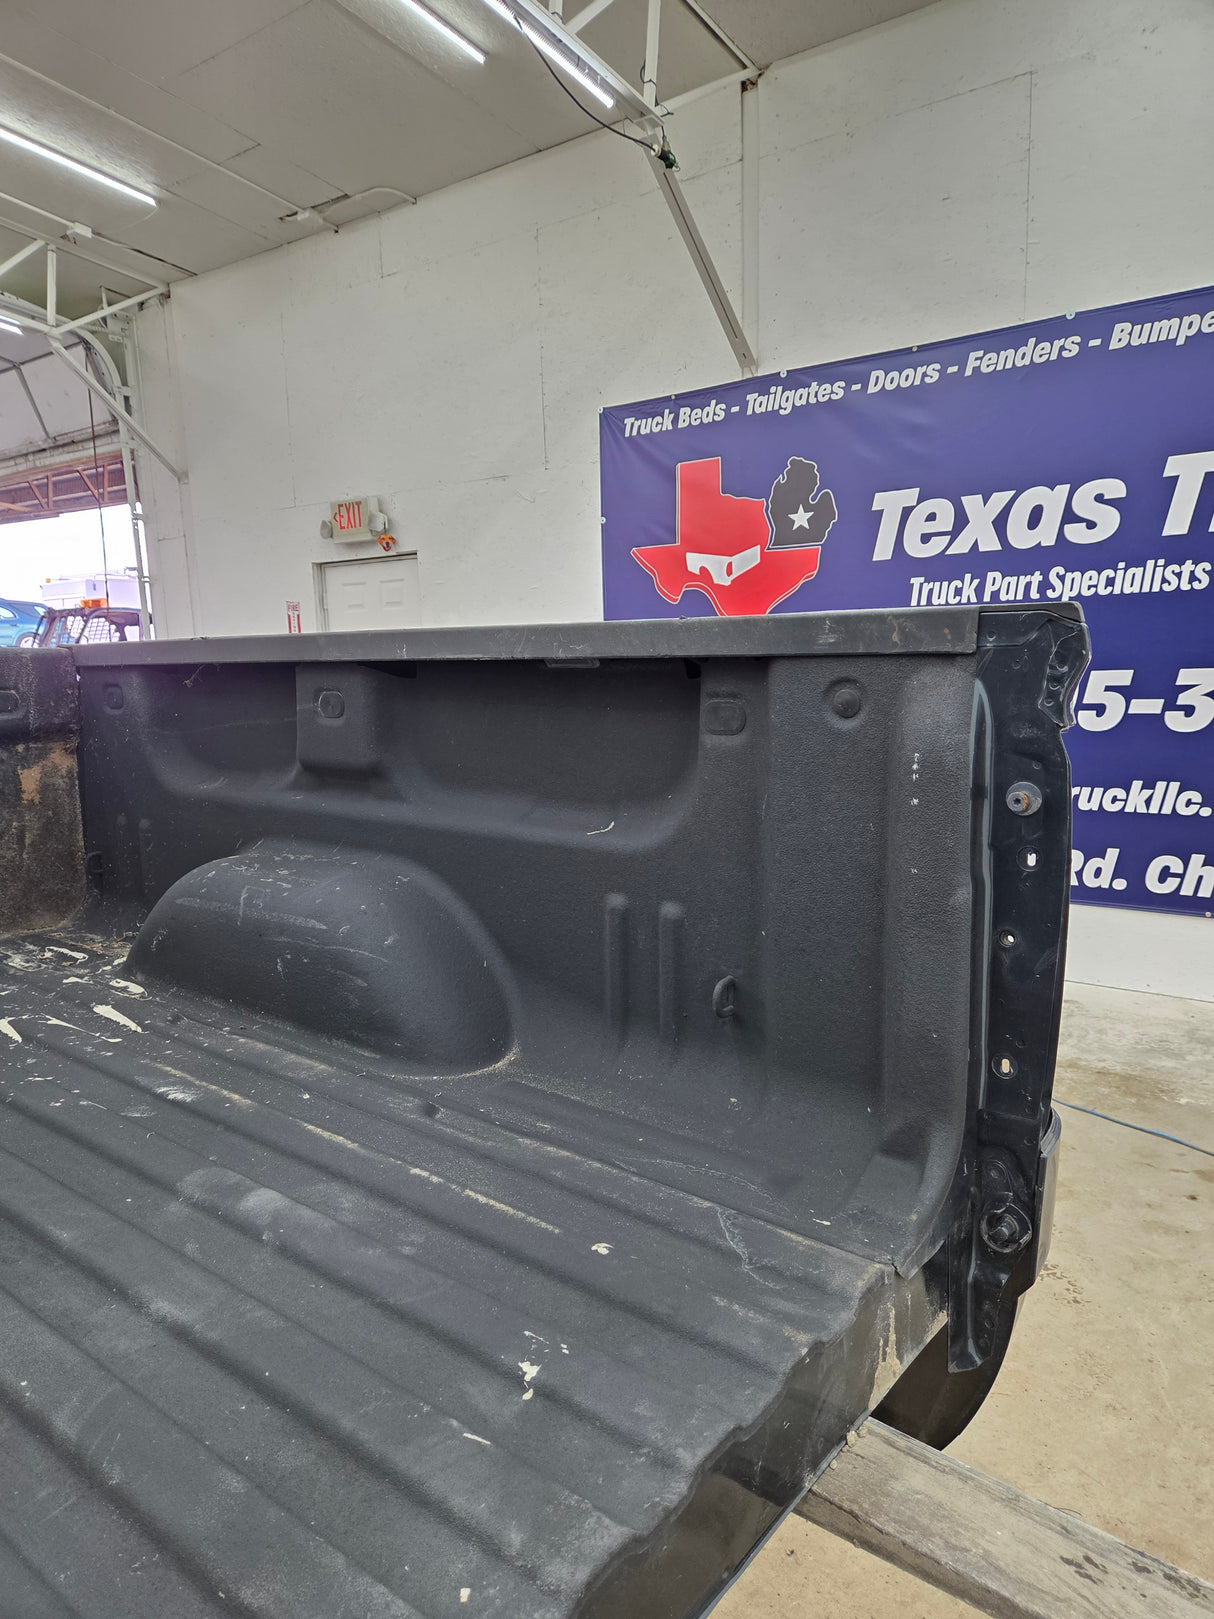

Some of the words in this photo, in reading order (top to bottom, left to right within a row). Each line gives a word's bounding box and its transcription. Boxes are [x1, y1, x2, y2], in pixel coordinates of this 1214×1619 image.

[624, 408, 675, 438] Truck
[677, 400, 726, 429] Beds
[745, 380, 846, 415] Tailgates
[867, 362, 941, 394] Doors
[964, 334, 1081, 376] Fenders
[338, 501, 362, 530] EXIT
[871, 478, 1127, 562] Texas
[1161, 450, 1214, 537] T
[909, 573, 981, 607] Truck
[983, 570, 1043, 602] Part
[1046, 558, 1212, 602] Specialists
